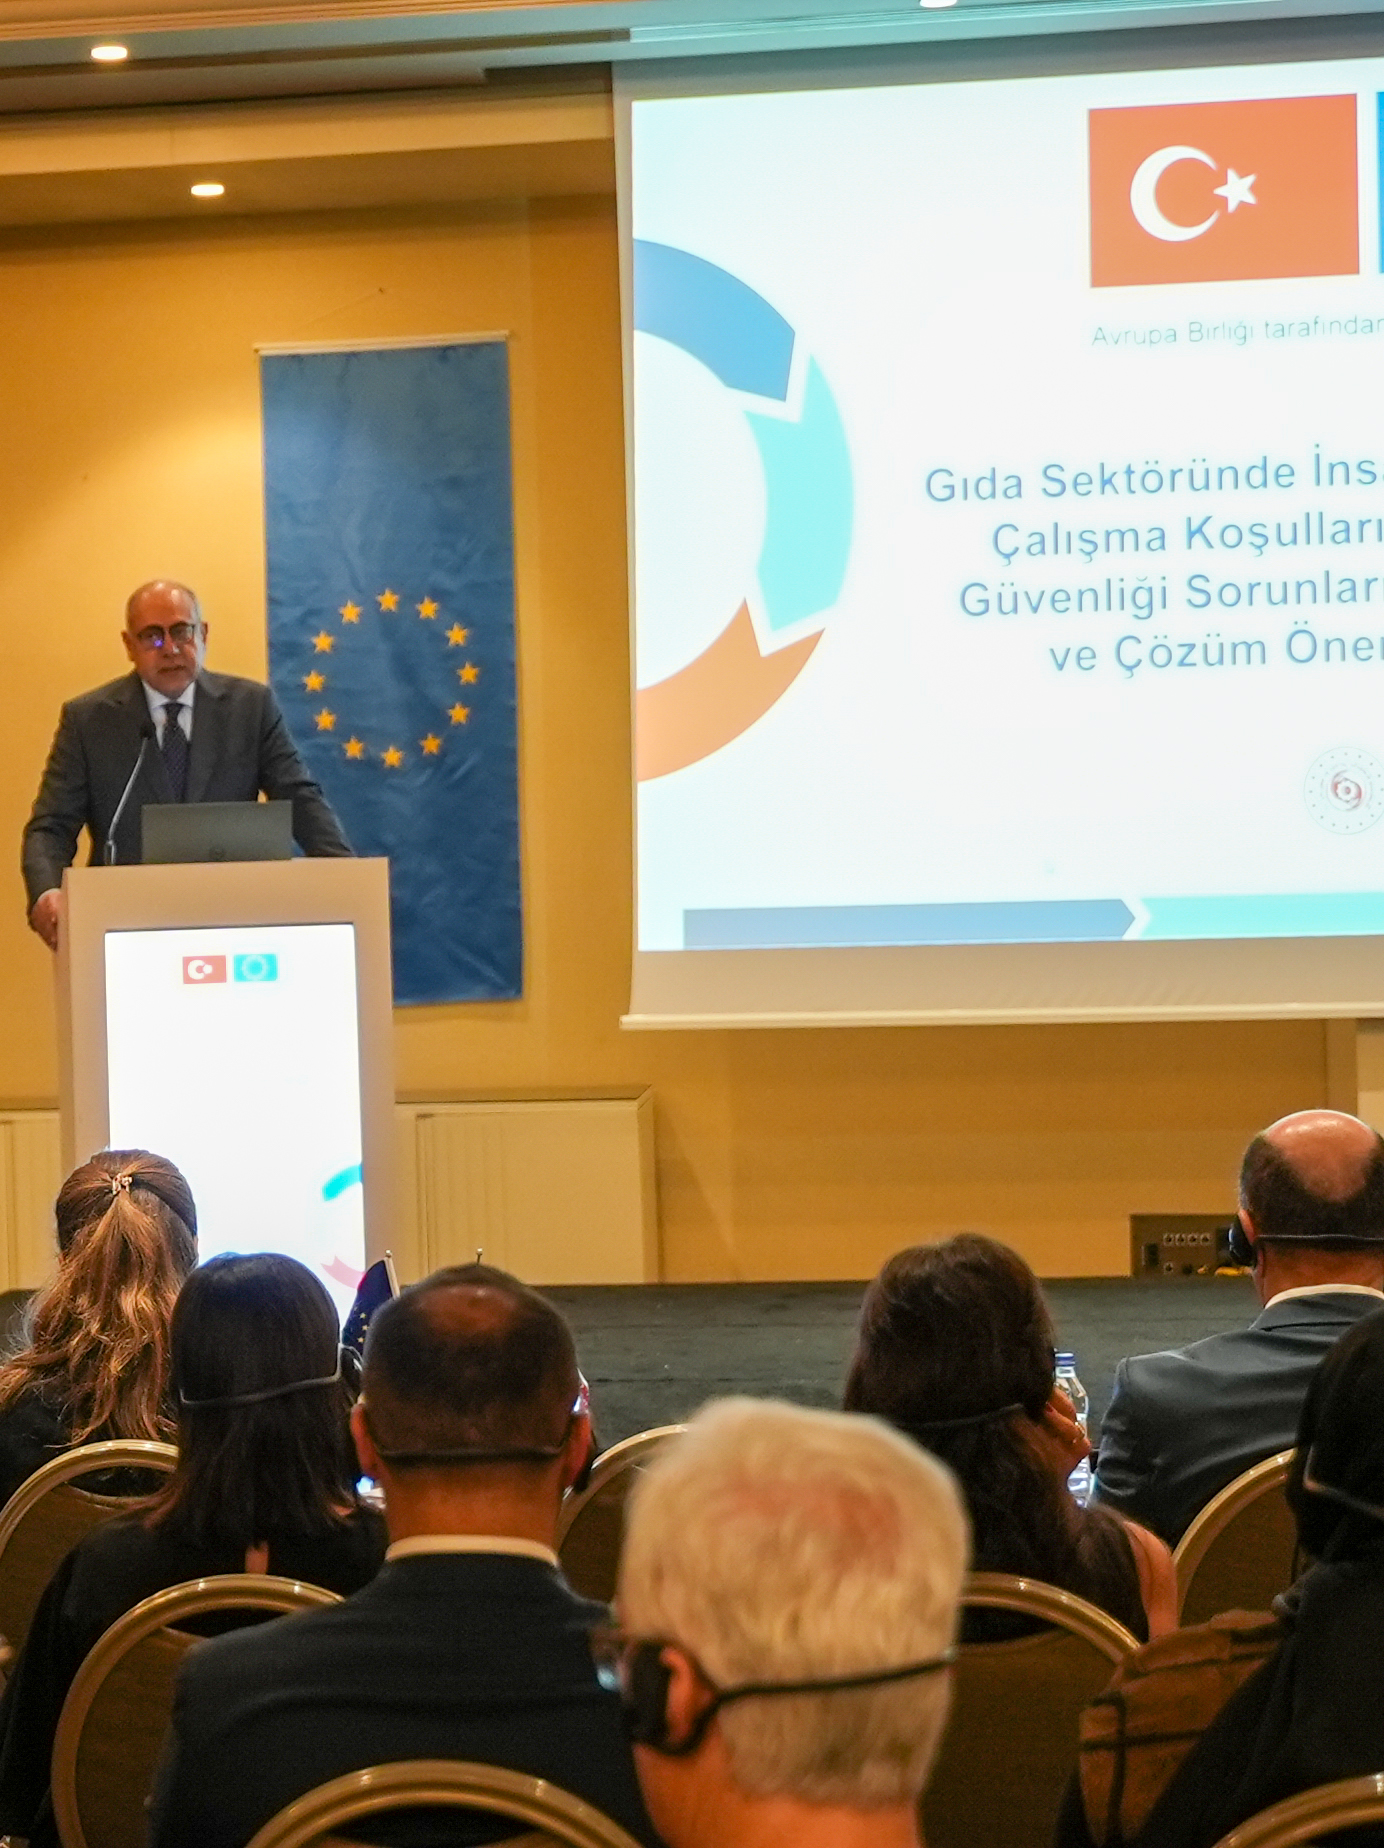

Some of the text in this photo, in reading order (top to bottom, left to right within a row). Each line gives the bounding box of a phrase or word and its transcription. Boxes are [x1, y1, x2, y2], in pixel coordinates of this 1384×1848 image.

[1092, 326, 1177, 348] Avrupa
[925, 442, 1384, 503] Gıda Sektöründe İns
[991, 510, 1384, 567] Çalışma Koşulları
[959, 569, 1384, 622] Güvenliği Sorunlar
[1048, 647, 1097, 672] ve
[1113, 632, 1267, 679] Çözüm
